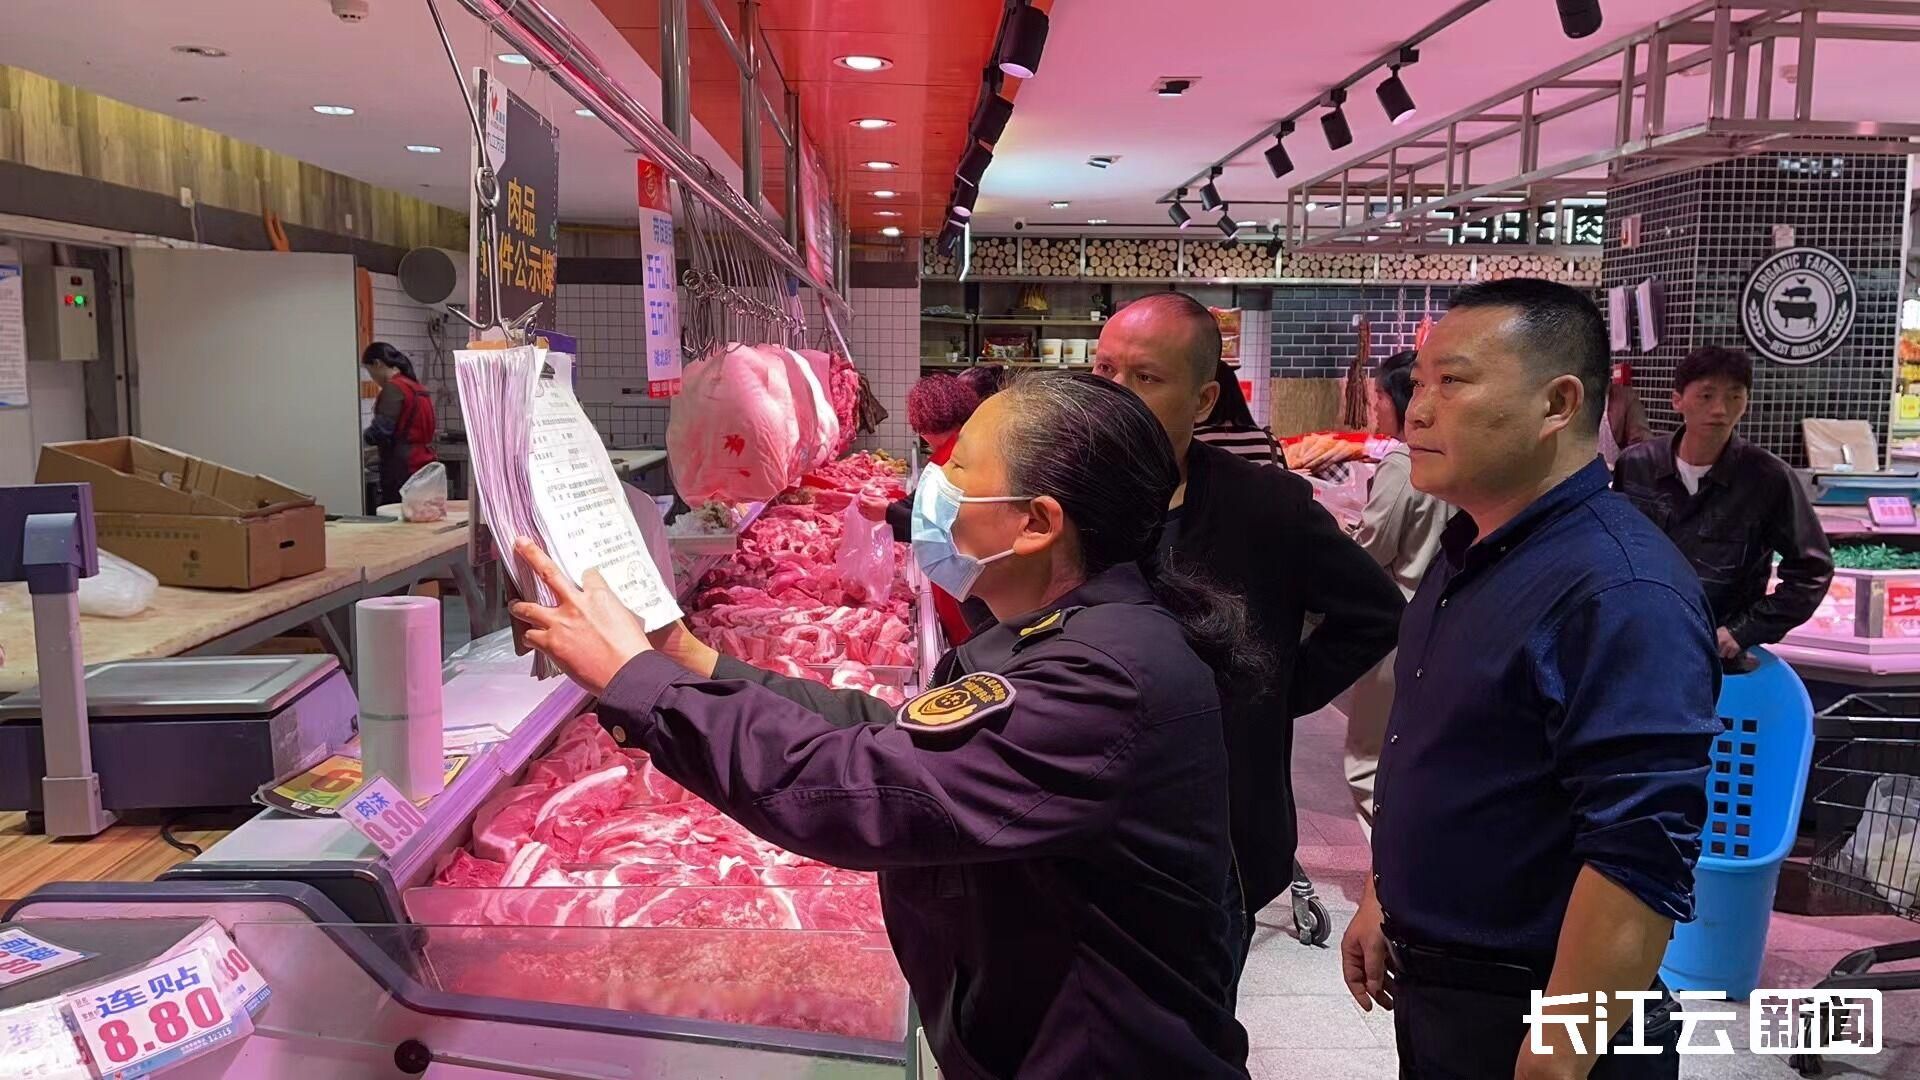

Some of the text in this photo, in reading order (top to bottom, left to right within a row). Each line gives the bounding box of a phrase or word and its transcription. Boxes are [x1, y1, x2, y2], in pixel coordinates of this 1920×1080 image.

[507, 177, 536, 237] 肉品
[1753, 254, 1849, 295] ORGANIC FARMING
[1770, 339, 1823, 357] BEST QUALITY
[1891, 593, 1920, 614] 土
[363, 800, 425, 850] 9.90
[0, 951, 42, 974] 80
[95, 965, 201, 1018] 连贴
[98, 987, 224, 1063] 8.80
[208, 1026, 233, 1043] 12315
